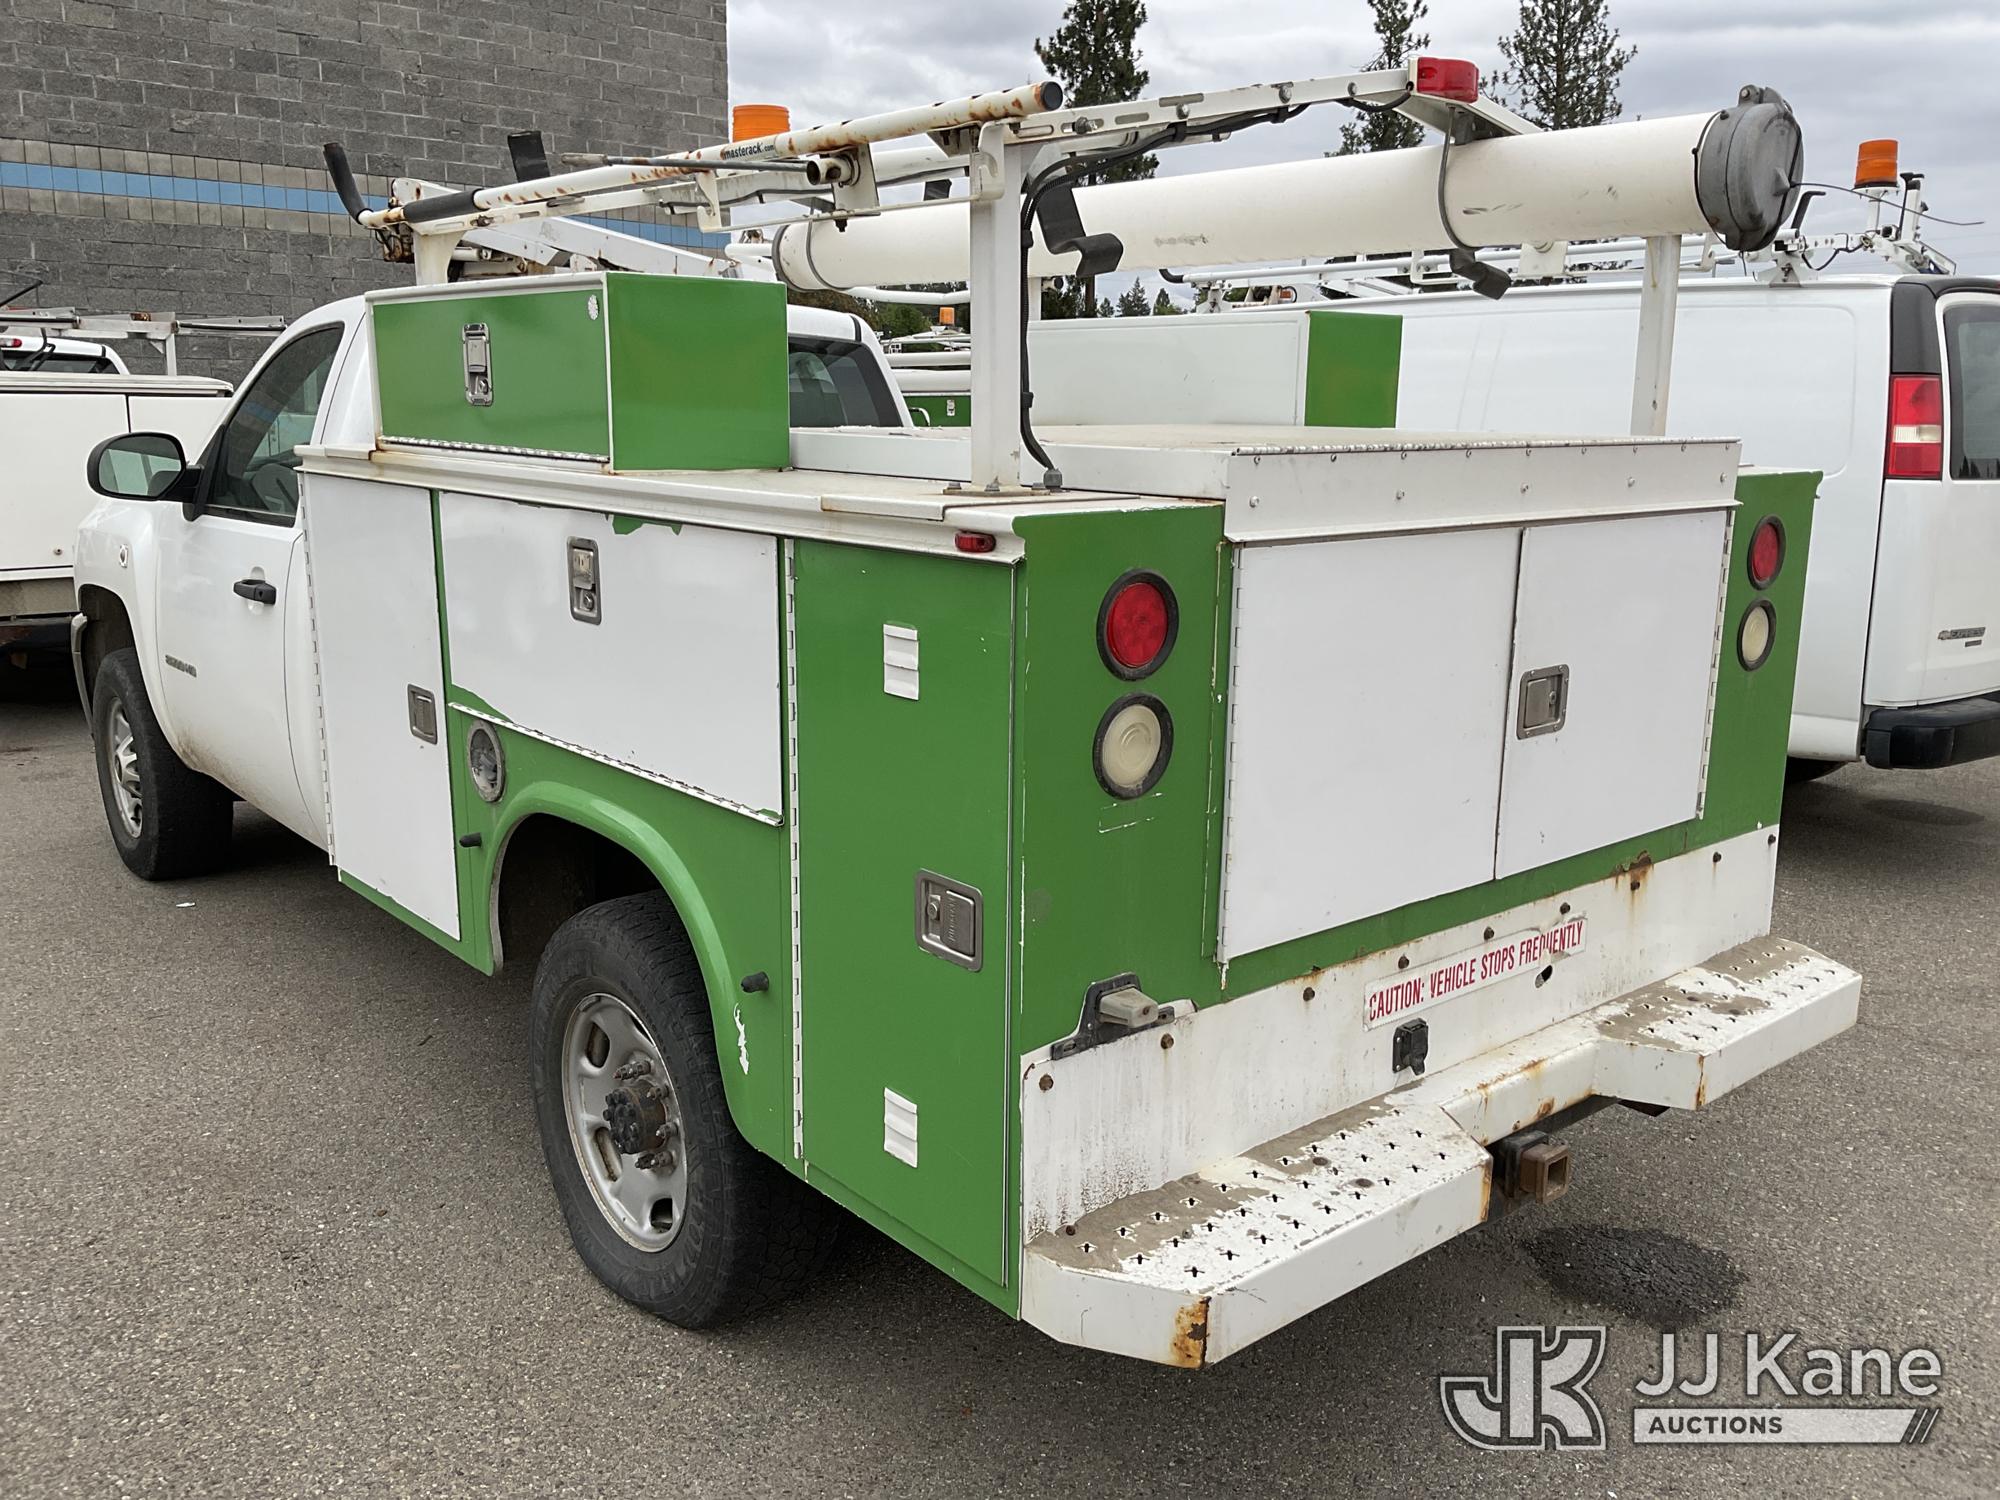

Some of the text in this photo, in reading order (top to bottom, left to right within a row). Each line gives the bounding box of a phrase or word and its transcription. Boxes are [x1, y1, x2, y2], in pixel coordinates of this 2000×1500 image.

[1369, 976, 1425, 1021] CAUTION:
[1430, 958, 1477, 998] VEHICLE
[1481, 944, 1515, 980] STOPS
